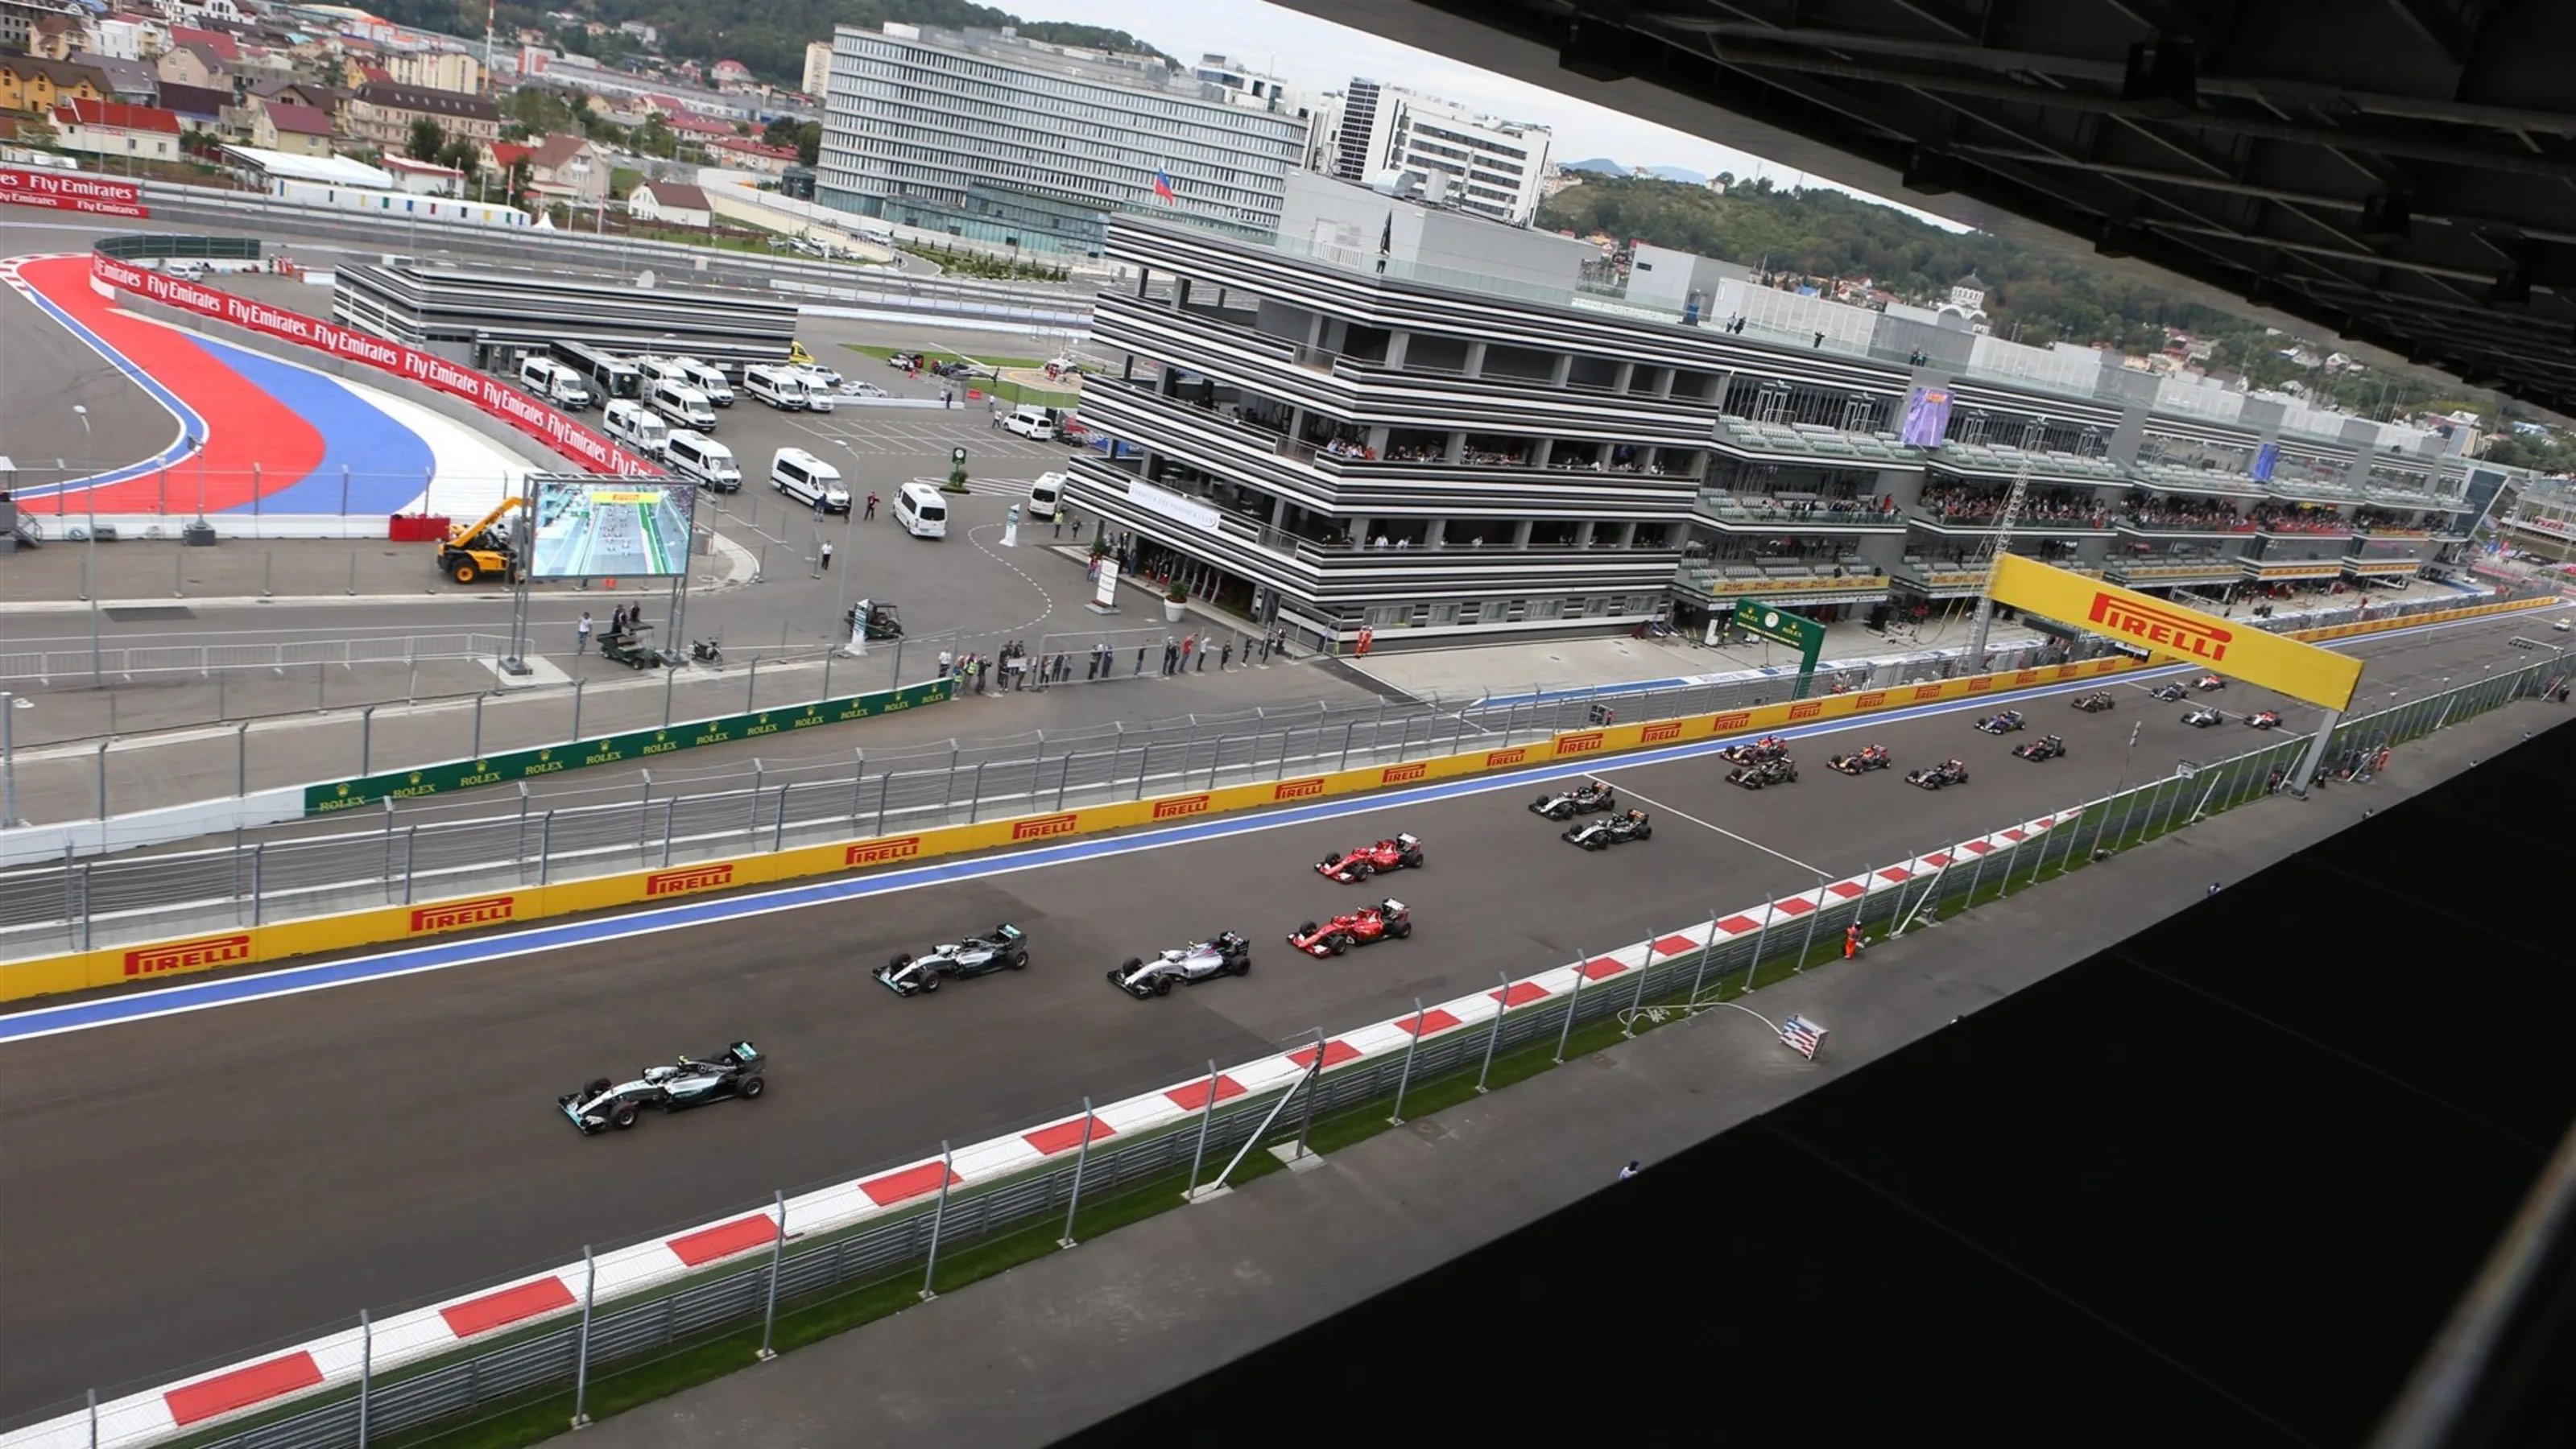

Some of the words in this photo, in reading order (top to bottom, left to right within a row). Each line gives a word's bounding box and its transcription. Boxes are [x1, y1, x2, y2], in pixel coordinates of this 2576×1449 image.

[29, 175, 59, 193] Fly
[61, 178, 133, 199] Emirates
[12, 192, 58, 206] Emirates
[76, 200, 94, 212] Fly
[96, 202, 139, 215] Emirates
[147, 275, 168, 299] Fly
[169, 281, 221, 312] Emirates
[228, 298, 251, 323] Fly
[251, 305, 307, 336] Emirates
[314, 324, 338, 350] Fly
[339, 332, 398, 365] Emirates
[405, 351, 429, 379] Fly
[429, 360, 478, 395] Emirates
[483, 381, 503, 410] Fly
[502, 392, 544, 427] Emirates
[548, 412, 565, 443] Fly
[564, 424, 606, 464] Emirates
[2088, 592, 2233, 663] PIRELLI
[885, 700, 910, 712] ROLEX
[1855, 692, 1886, 708] PIRELLI
[795, 714, 825, 728] ROLEX
[841, 707, 869, 720] ROLEX
[1788, 702, 1822, 720] PIRELLI
[747, 724, 779, 736] ROLEX
[1714, 712, 1751, 732] PIRELLI
[696, 731, 729, 745] ROLEX
[1640, 722, 1682, 743] PIRELLI
[643, 741, 677, 755] ROLEX
[1557, 733, 1603, 754] PIRELLI
[525, 760, 564, 775] ROLEX
[585, 750, 622, 766] ROLEX
[1486, 749, 1526, 767] PIRELLI
[461, 771, 502, 787] ROLEX
[1382, 763, 1427, 783] PIRELLI
[392, 783, 436, 799] ROLEX
[1275, 778, 1325, 800] PIRELLI
[320, 795, 366, 812] ROLEX
[1153, 795, 1210, 819] PIRELLI
[1012, 814, 1077, 840] PIRELLI
[846, 836, 920, 865] PIRELLI
[647, 864, 734, 896] PIRELLI
[411, 896, 515, 932] PIRELLI
[124, 934, 250, 976] PIRELLI
